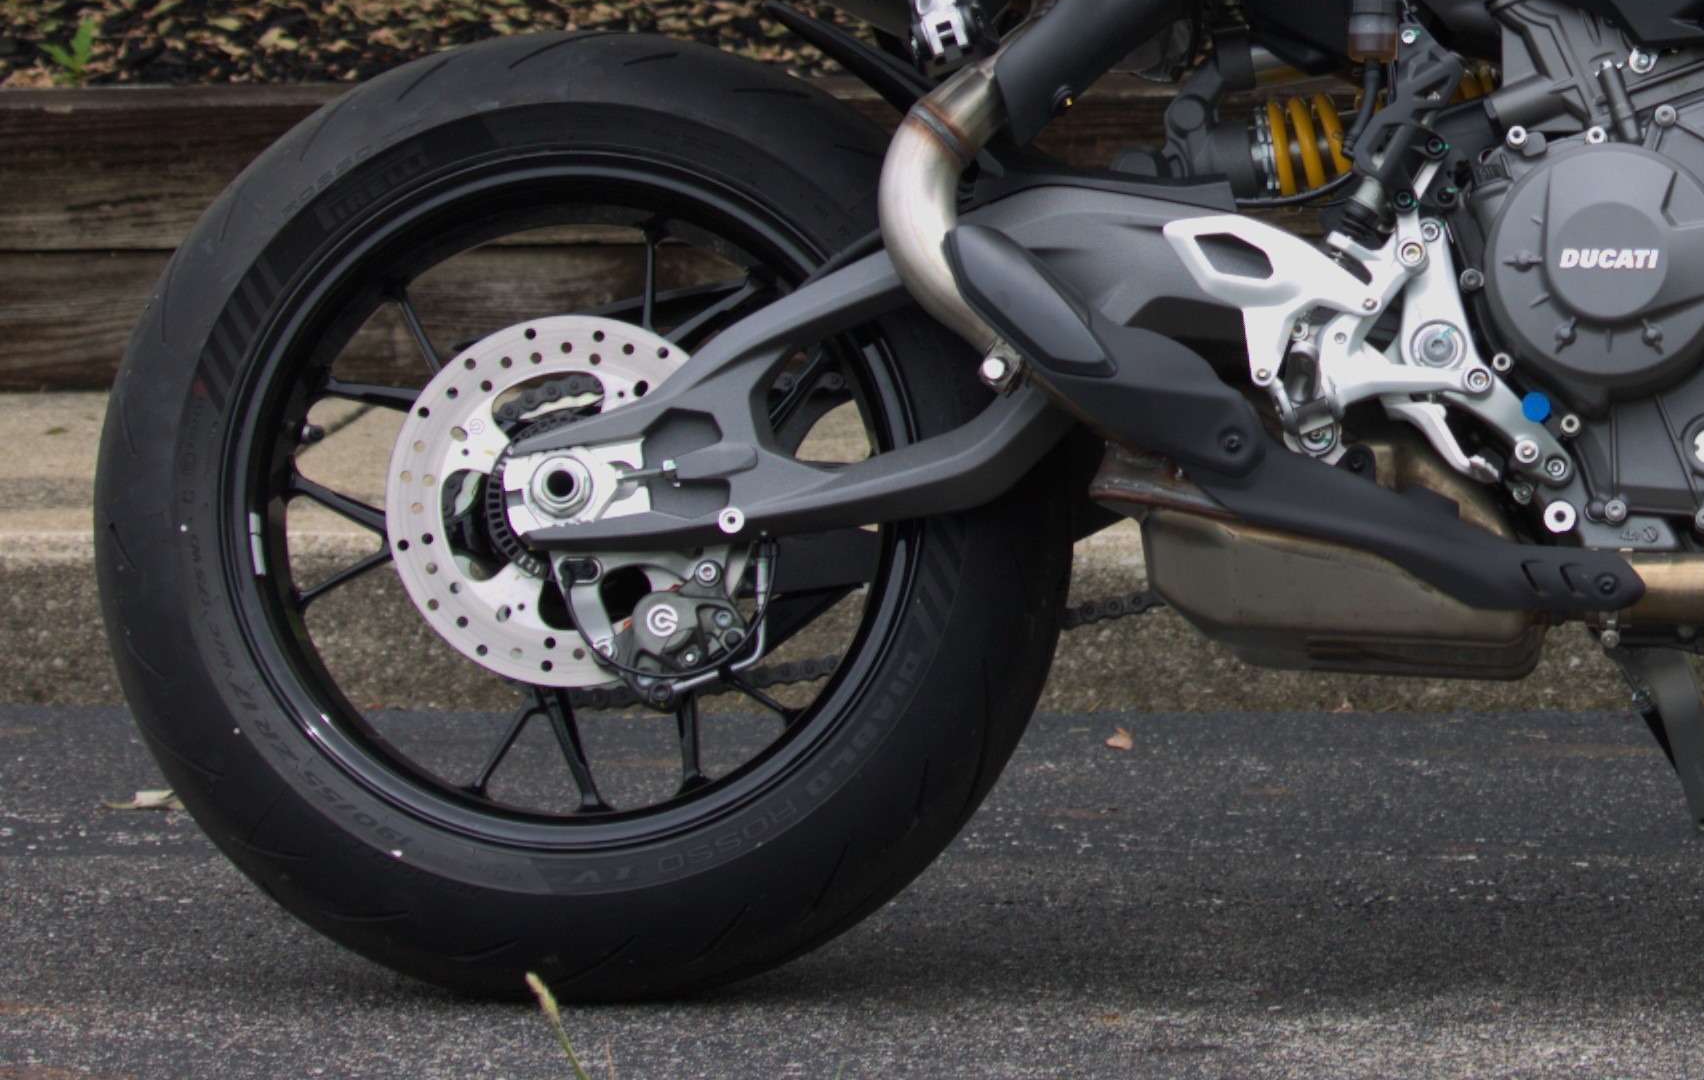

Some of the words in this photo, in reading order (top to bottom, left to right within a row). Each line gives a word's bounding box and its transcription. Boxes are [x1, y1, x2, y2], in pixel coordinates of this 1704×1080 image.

[280, 143, 373, 216] ROSSO
[308, 143, 430, 229] PIRELLI
[1559, 248, 1659, 269] DUCATI
[801, 647, 925, 802] DIABLO
[293, 760, 413, 853] 190/55
[653, 794, 800, 877] ROSSO
[567, 863, 637, 886] IV
